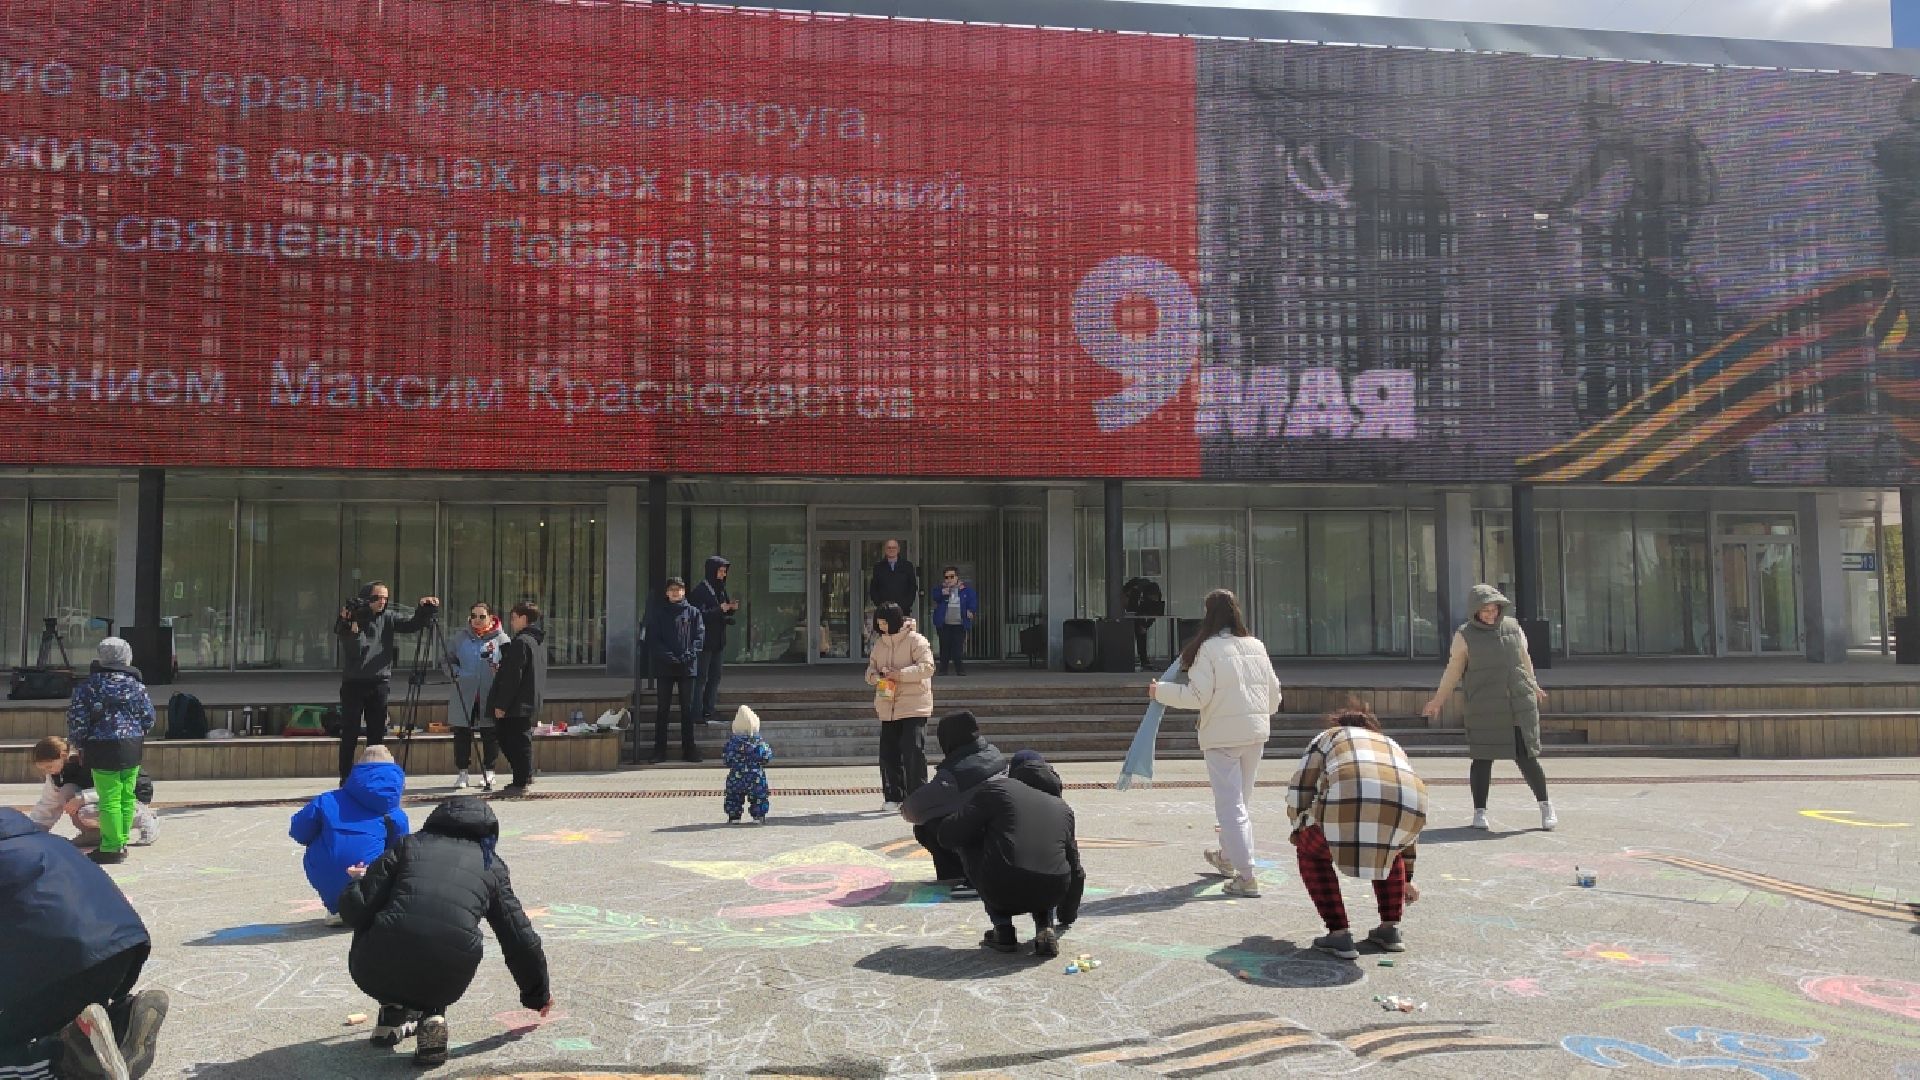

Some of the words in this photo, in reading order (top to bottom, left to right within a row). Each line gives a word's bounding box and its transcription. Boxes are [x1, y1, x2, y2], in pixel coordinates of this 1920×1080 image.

[99, 63, 394, 120] ветераны
[415, 82, 447, 115] и
[468, 88, 675, 127] жители
[699, 98, 883, 149] округа,
[0, 128, 192, 178] живёт
[216, 145, 248, 183] в
[270, 147, 516, 197] сердцах
[537, 162, 662, 200] всех
[683, 168, 967, 211] поколений
[115, 215, 458, 265] священной
[482, 216, 713, 280] Победе!
[1071, 255, 1199, 432] 9
[270, 358, 502, 412] Максим
[1195, 365, 1416, 439] МАЯ
